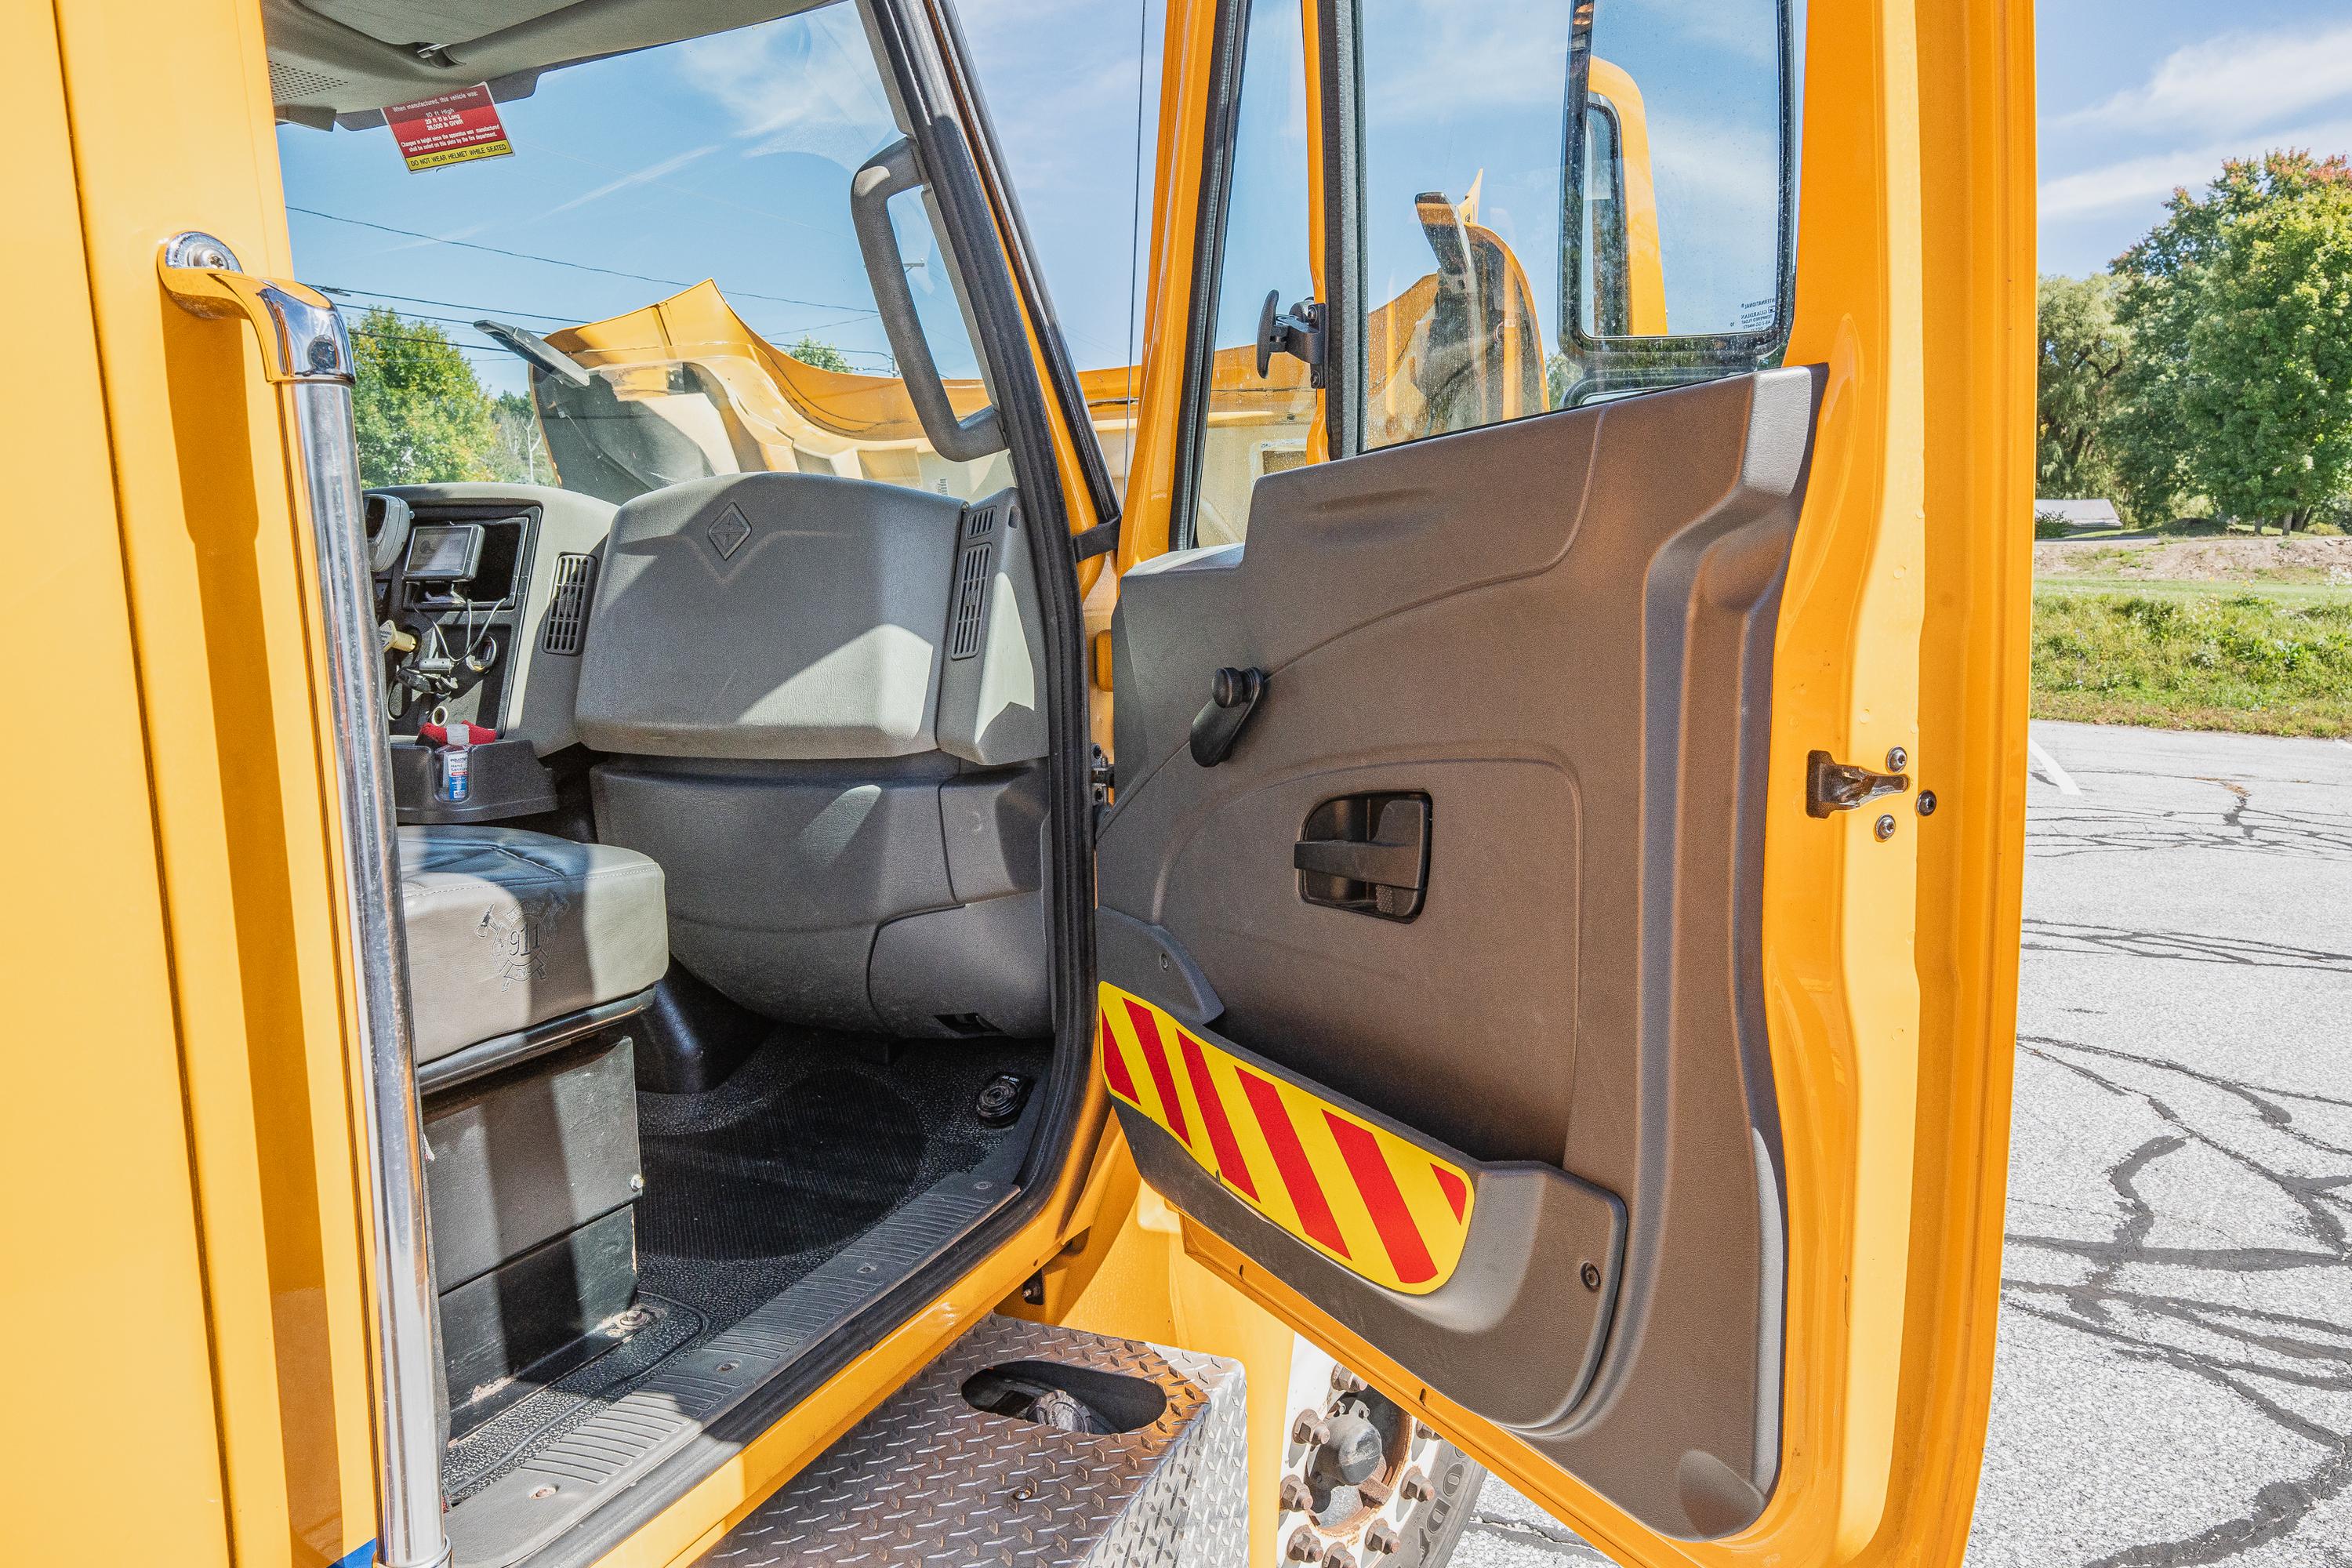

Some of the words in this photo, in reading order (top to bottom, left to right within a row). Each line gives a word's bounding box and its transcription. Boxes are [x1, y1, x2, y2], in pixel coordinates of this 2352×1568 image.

[407, 99, 439, 110] manufactured,
[475, 124, 500, 133] manufactured
[447, 151, 468, 160] HELMET
[468, 147, 486, 156] WHILE
[486, 143, 506, 153] SEATED
